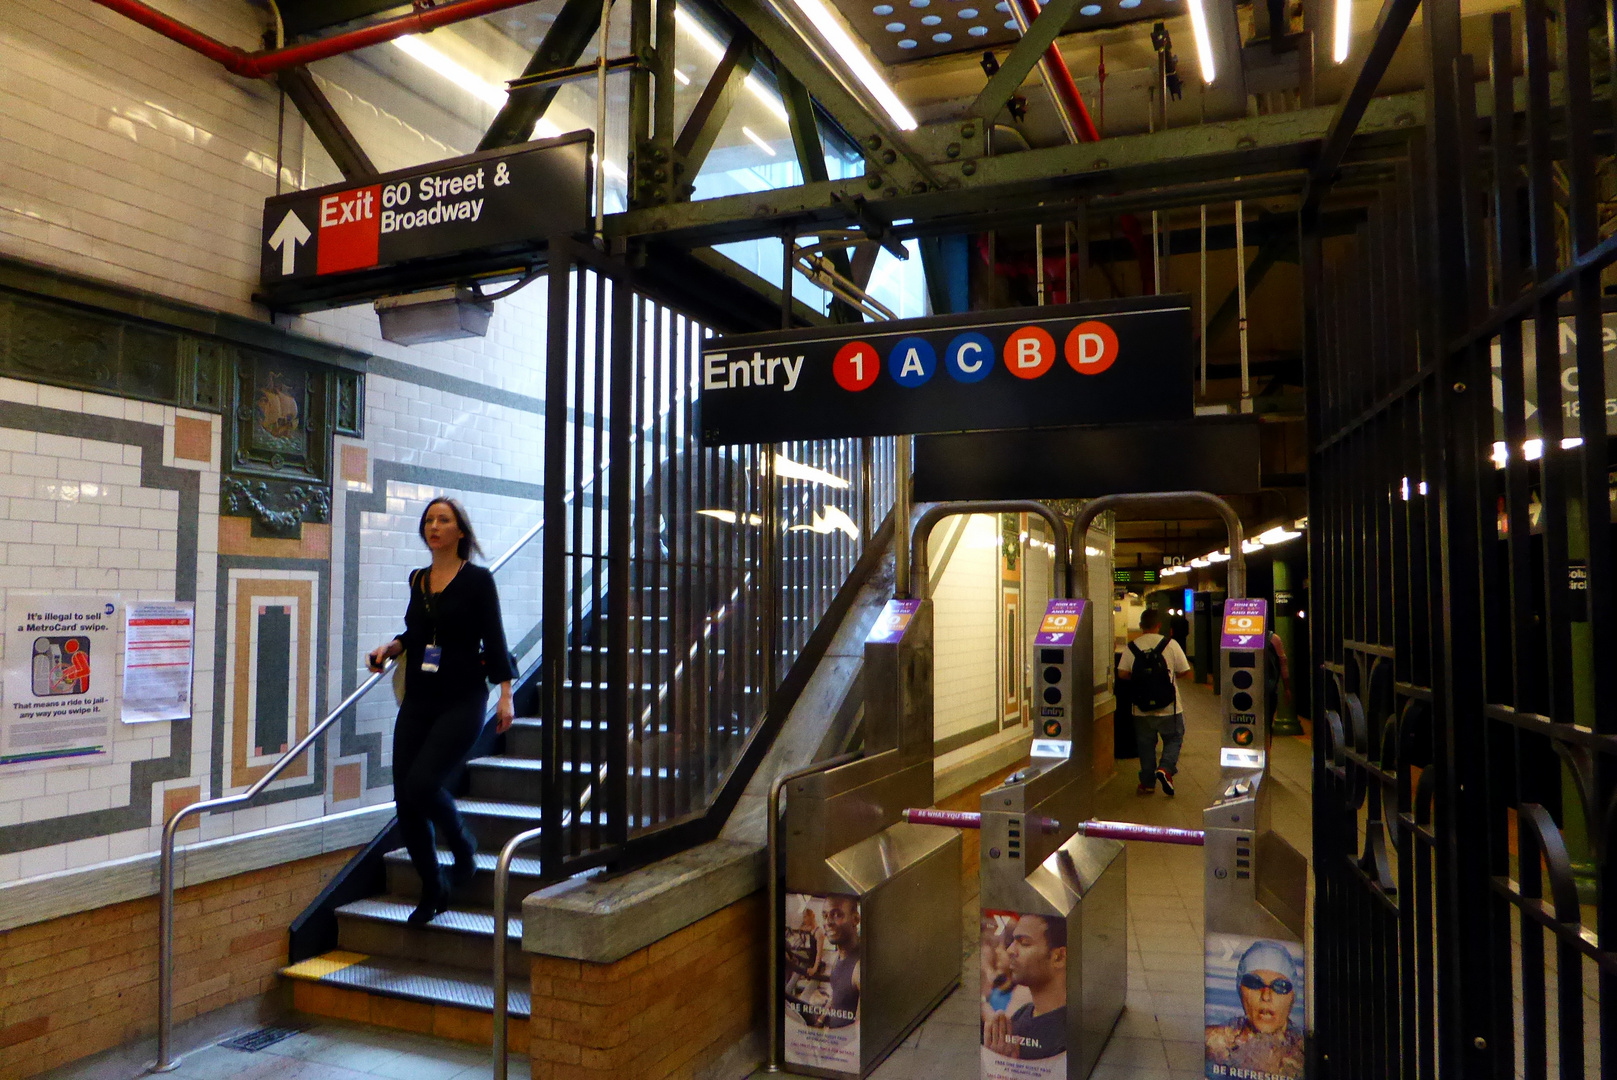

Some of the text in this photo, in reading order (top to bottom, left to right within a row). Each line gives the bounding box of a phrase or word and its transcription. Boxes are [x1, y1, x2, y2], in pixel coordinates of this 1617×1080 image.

[382, 161, 511, 208] 60 Street &
[321, 191, 374, 228] Exit
[381, 198, 484, 234] Broadway
[704, 333, 1104, 392] Entry 1 A C B D
[28, 612, 42, 620] It's
[44, 612, 72, 622] illegal
[26, 623, 77, 632] MetroCard
[80, 624, 108, 632] swipe.
[68, 707, 91, 715] swipe
[1231, 714, 1254, 724] Entry
[790, 1002, 856, 1020] BE RECHARGED.
[1005, 1034, 1042, 1048] BE ZEN.
[1213, 1064, 1226, 1074] BE
